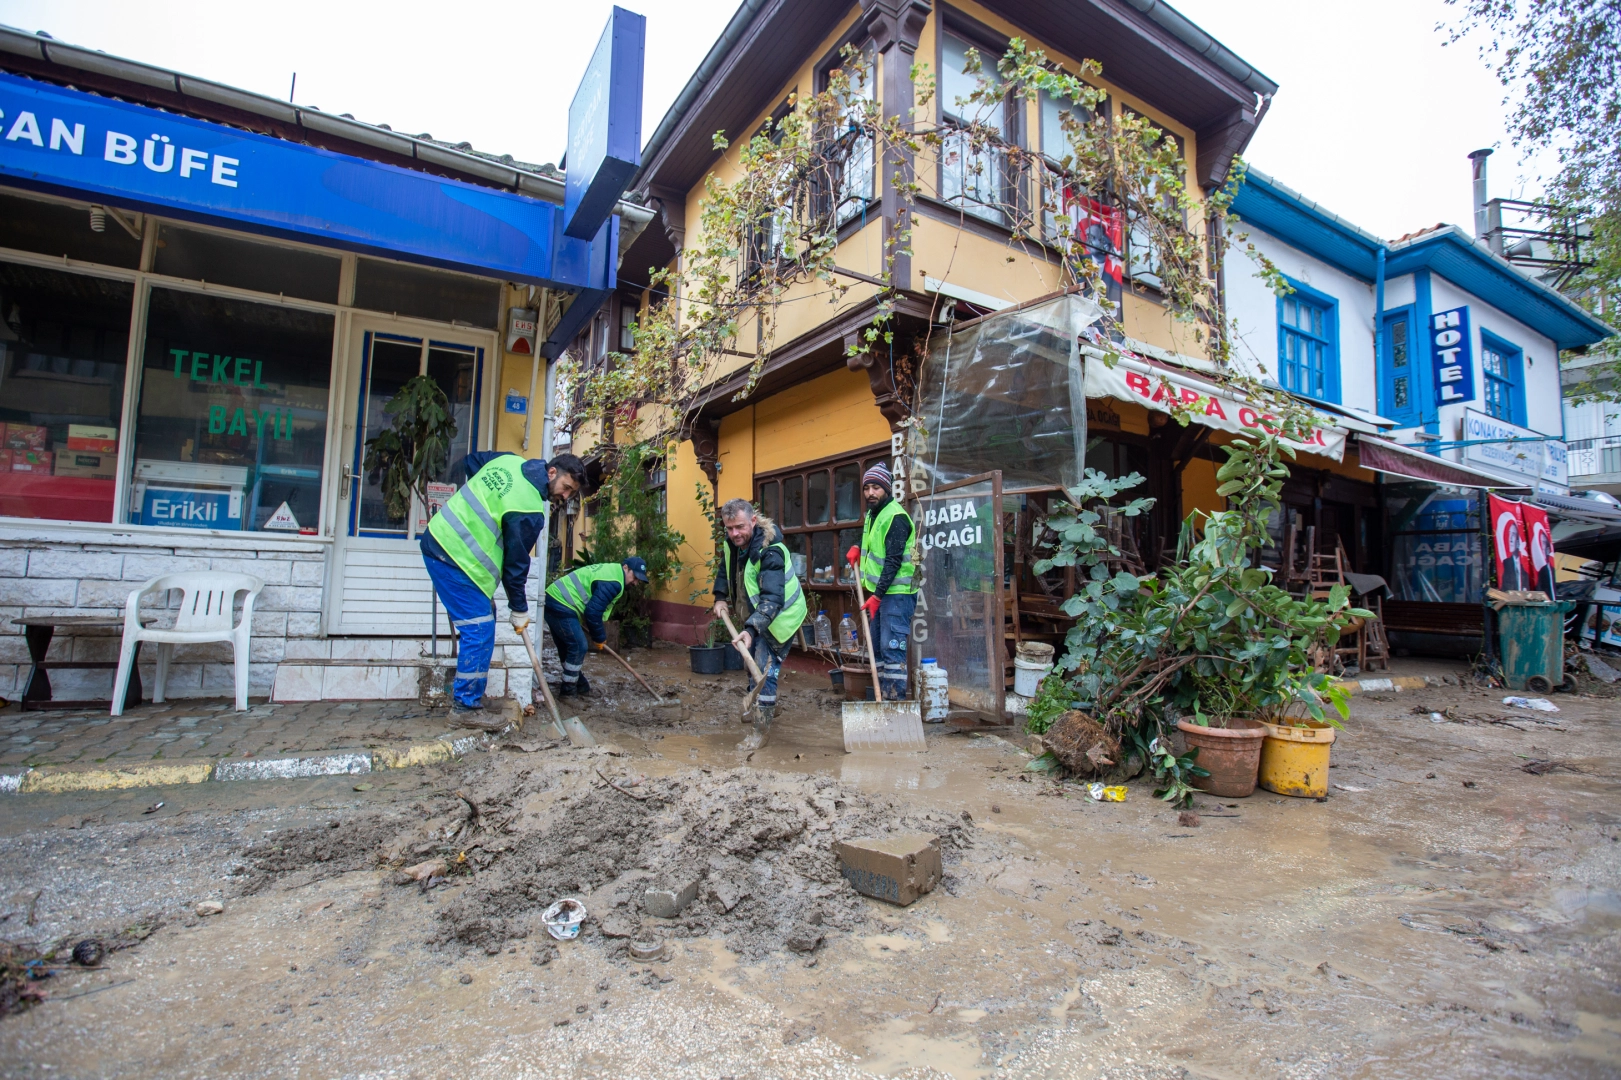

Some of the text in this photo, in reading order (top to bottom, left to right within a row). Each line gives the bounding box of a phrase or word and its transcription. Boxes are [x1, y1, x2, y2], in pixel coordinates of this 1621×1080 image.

[0, 108, 240, 188] AN BÜFE
[170, 348, 269, 390] TEKEL
[1434, 311, 1463, 401] HOTEL
[208, 404, 293, 440] BAYİİ
[1239, 407, 1327, 447] OCI
[1468, 418, 1497, 439] KONAK
[891, 432, 906, 503] BAB
[151, 498, 218, 521] Erikli
[925, 501, 977, 527] BABA
[921, 524, 982, 550] OCAĞI
